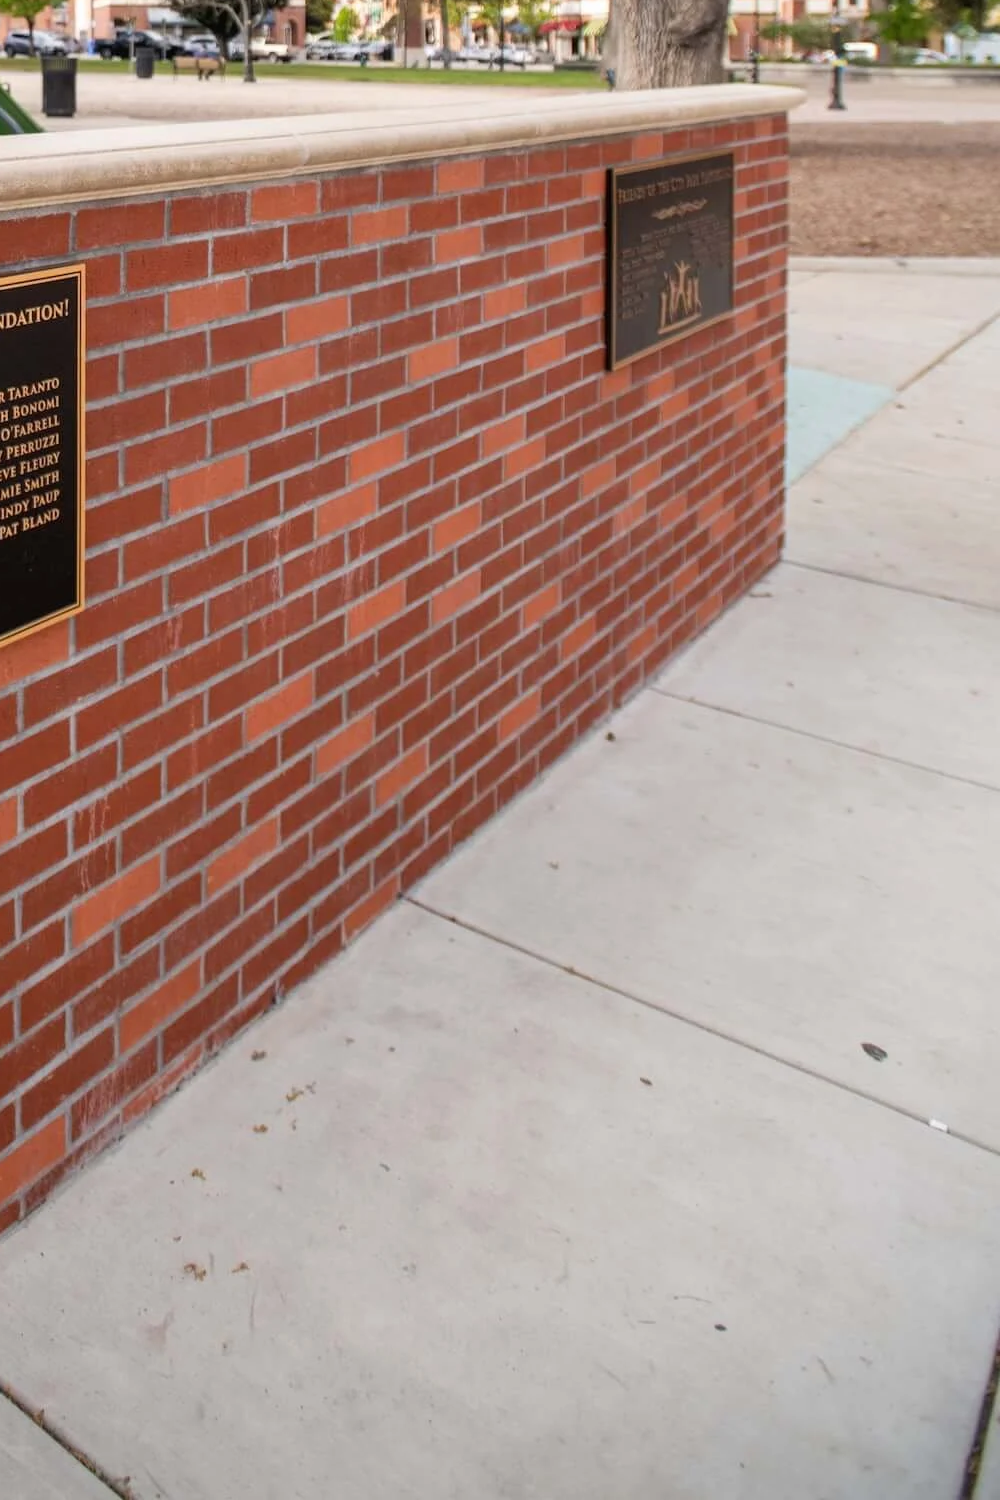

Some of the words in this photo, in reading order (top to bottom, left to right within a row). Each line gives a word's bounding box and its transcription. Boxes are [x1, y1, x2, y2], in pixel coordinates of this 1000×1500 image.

[7, 377, 60, 401] TARANTO
[12, 395, 60, 420] BONOMI
[6, 433, 60, 460] PERRUZZI
[20, 451, 61, 475] FLEURY
[24, 470, 60, 493] SMITH
[32, 489, 60, 509] PAUP
[22, 508, 60, 532] BLAND
